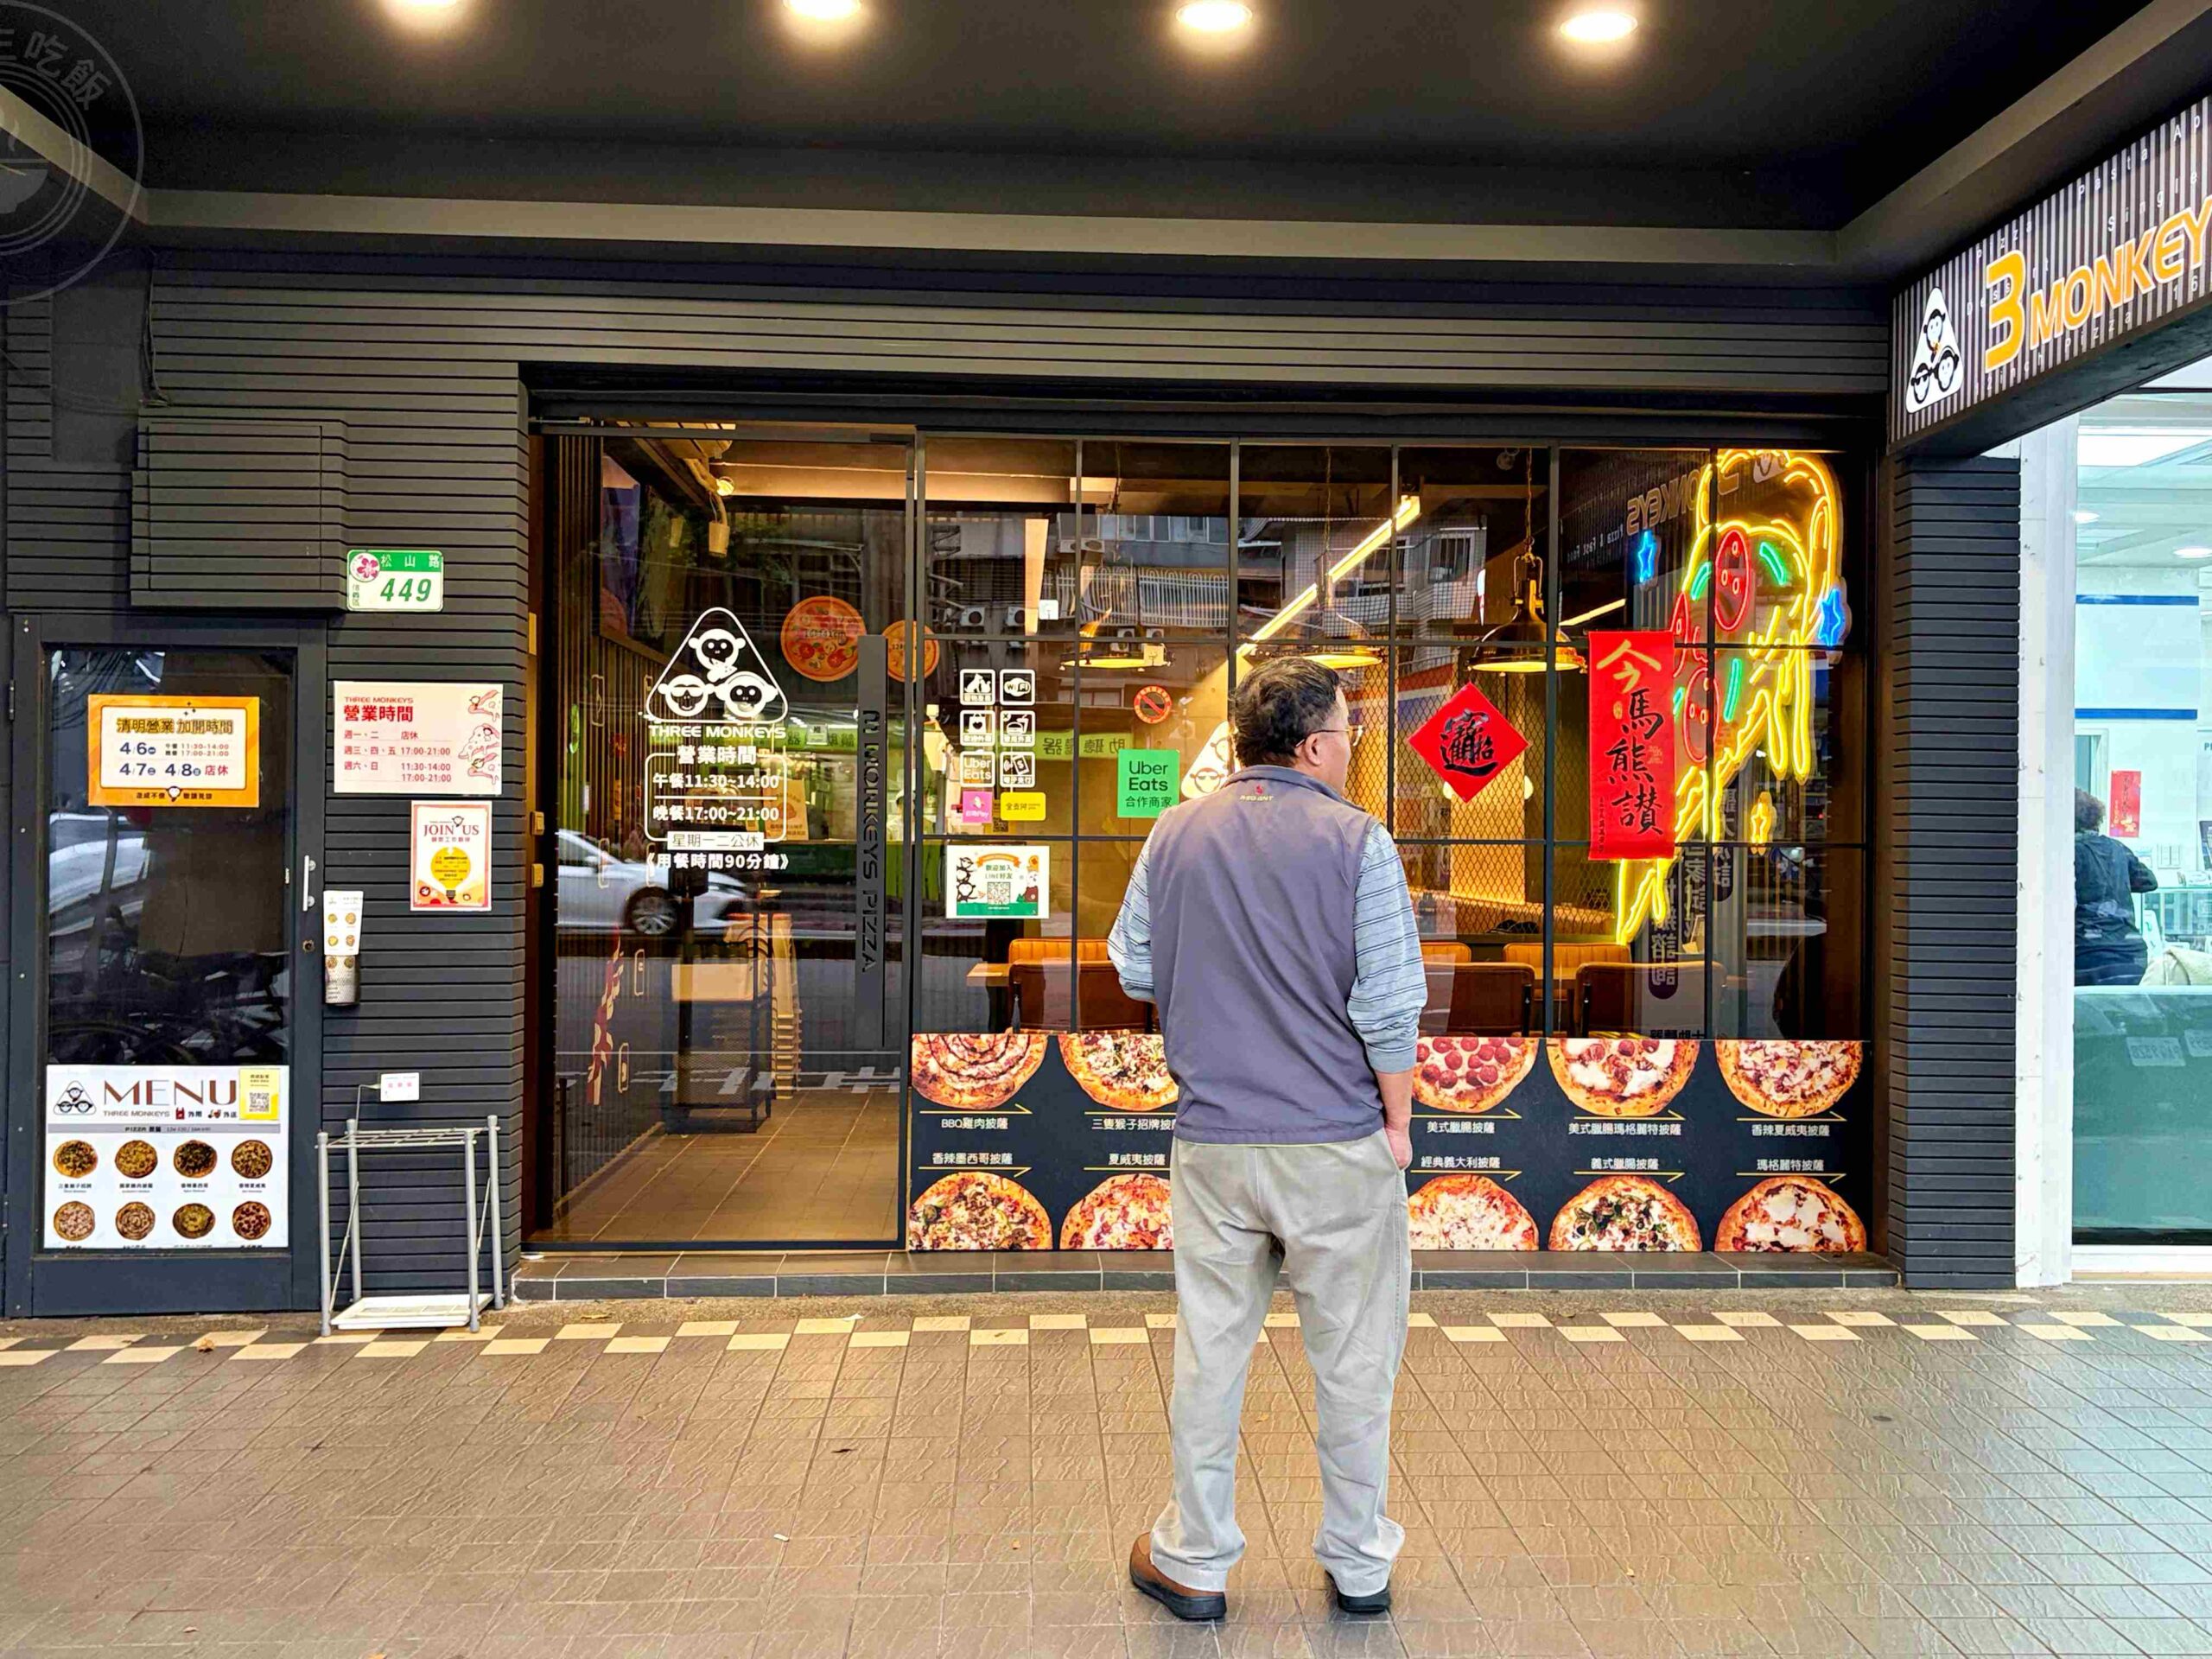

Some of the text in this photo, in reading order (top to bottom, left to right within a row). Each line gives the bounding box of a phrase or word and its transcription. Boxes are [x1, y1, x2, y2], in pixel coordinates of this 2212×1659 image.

[2079, 149, 2147, 199] Pasta
[2107, 172, 2197, 232] Single
[1985, 250, 2026, 374] 3
[2065, 312, 2131, 353] Pizza
[381, 554, 440, 568] 松山路
[380, 578, 431, 601] 449
[344, 705, 413, 722] 營業時間
[117, 718, 233, 734] 清明營業 加開時間
[648, 725, 702, 738] THREE
[706, 726, 786, 739] MONKEYS
[401, 731, 418, 740] 店休
[677, 746, 757, 765] 營業時間
[964, 757, 991, 768] Uber
[205, 765, 228, 775] 店休
[964, 768, 991, 779] Eats
[1129, 760, 1168, 775] Uber
[1129, 778, 1168, 791] Eats
[1125, 796, 1173, 809] 合作商家
[863, 743, 879, 880] MONKEYS
[423, 824, 479, 836] JOIN US
[671, 833, 760, 849] 星期一二公休
[862, 890, 878, 973] PIZZA
[104, 1080, 237, 1106] MENU
[941, 1118, 1009, 1130] BBQ雞肉披薩
[1751, 1124, 1830, 1137] 香辣夏威夷披薩
[932, 1153, 1013, 1165] 香辣墨西哥披薩
[1109, 1154, 1166, 1166] 夏威夷披薩
[1421, 1156, 1500, 1168] 經典義大利披薩
[1757, 1159, 1825, 1172] 瑪格麗特披薩
